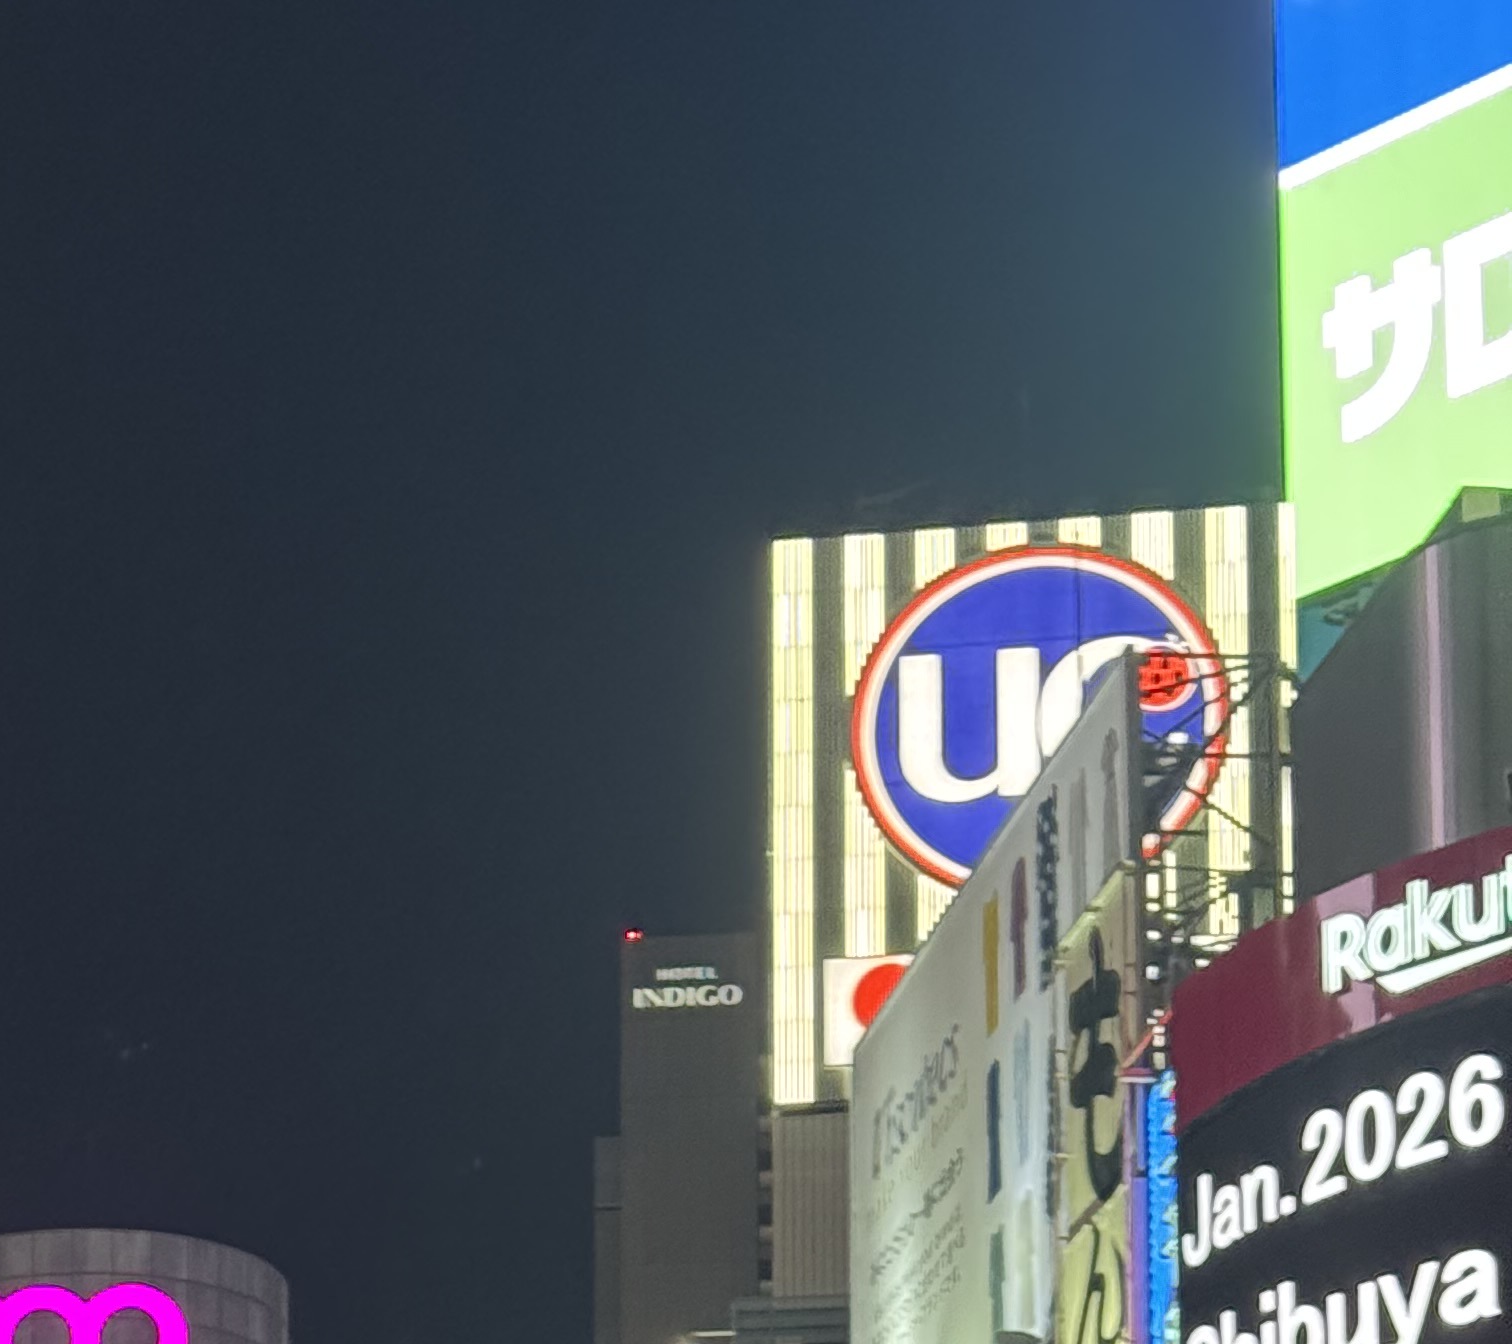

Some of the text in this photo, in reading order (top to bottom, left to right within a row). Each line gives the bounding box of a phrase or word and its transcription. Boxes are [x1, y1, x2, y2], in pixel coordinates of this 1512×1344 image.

[1321, 210, 1512, 444] サロ
[656, 966, 719, 981] HOTEL
[632, 984, 744, 1009] INDIGO
